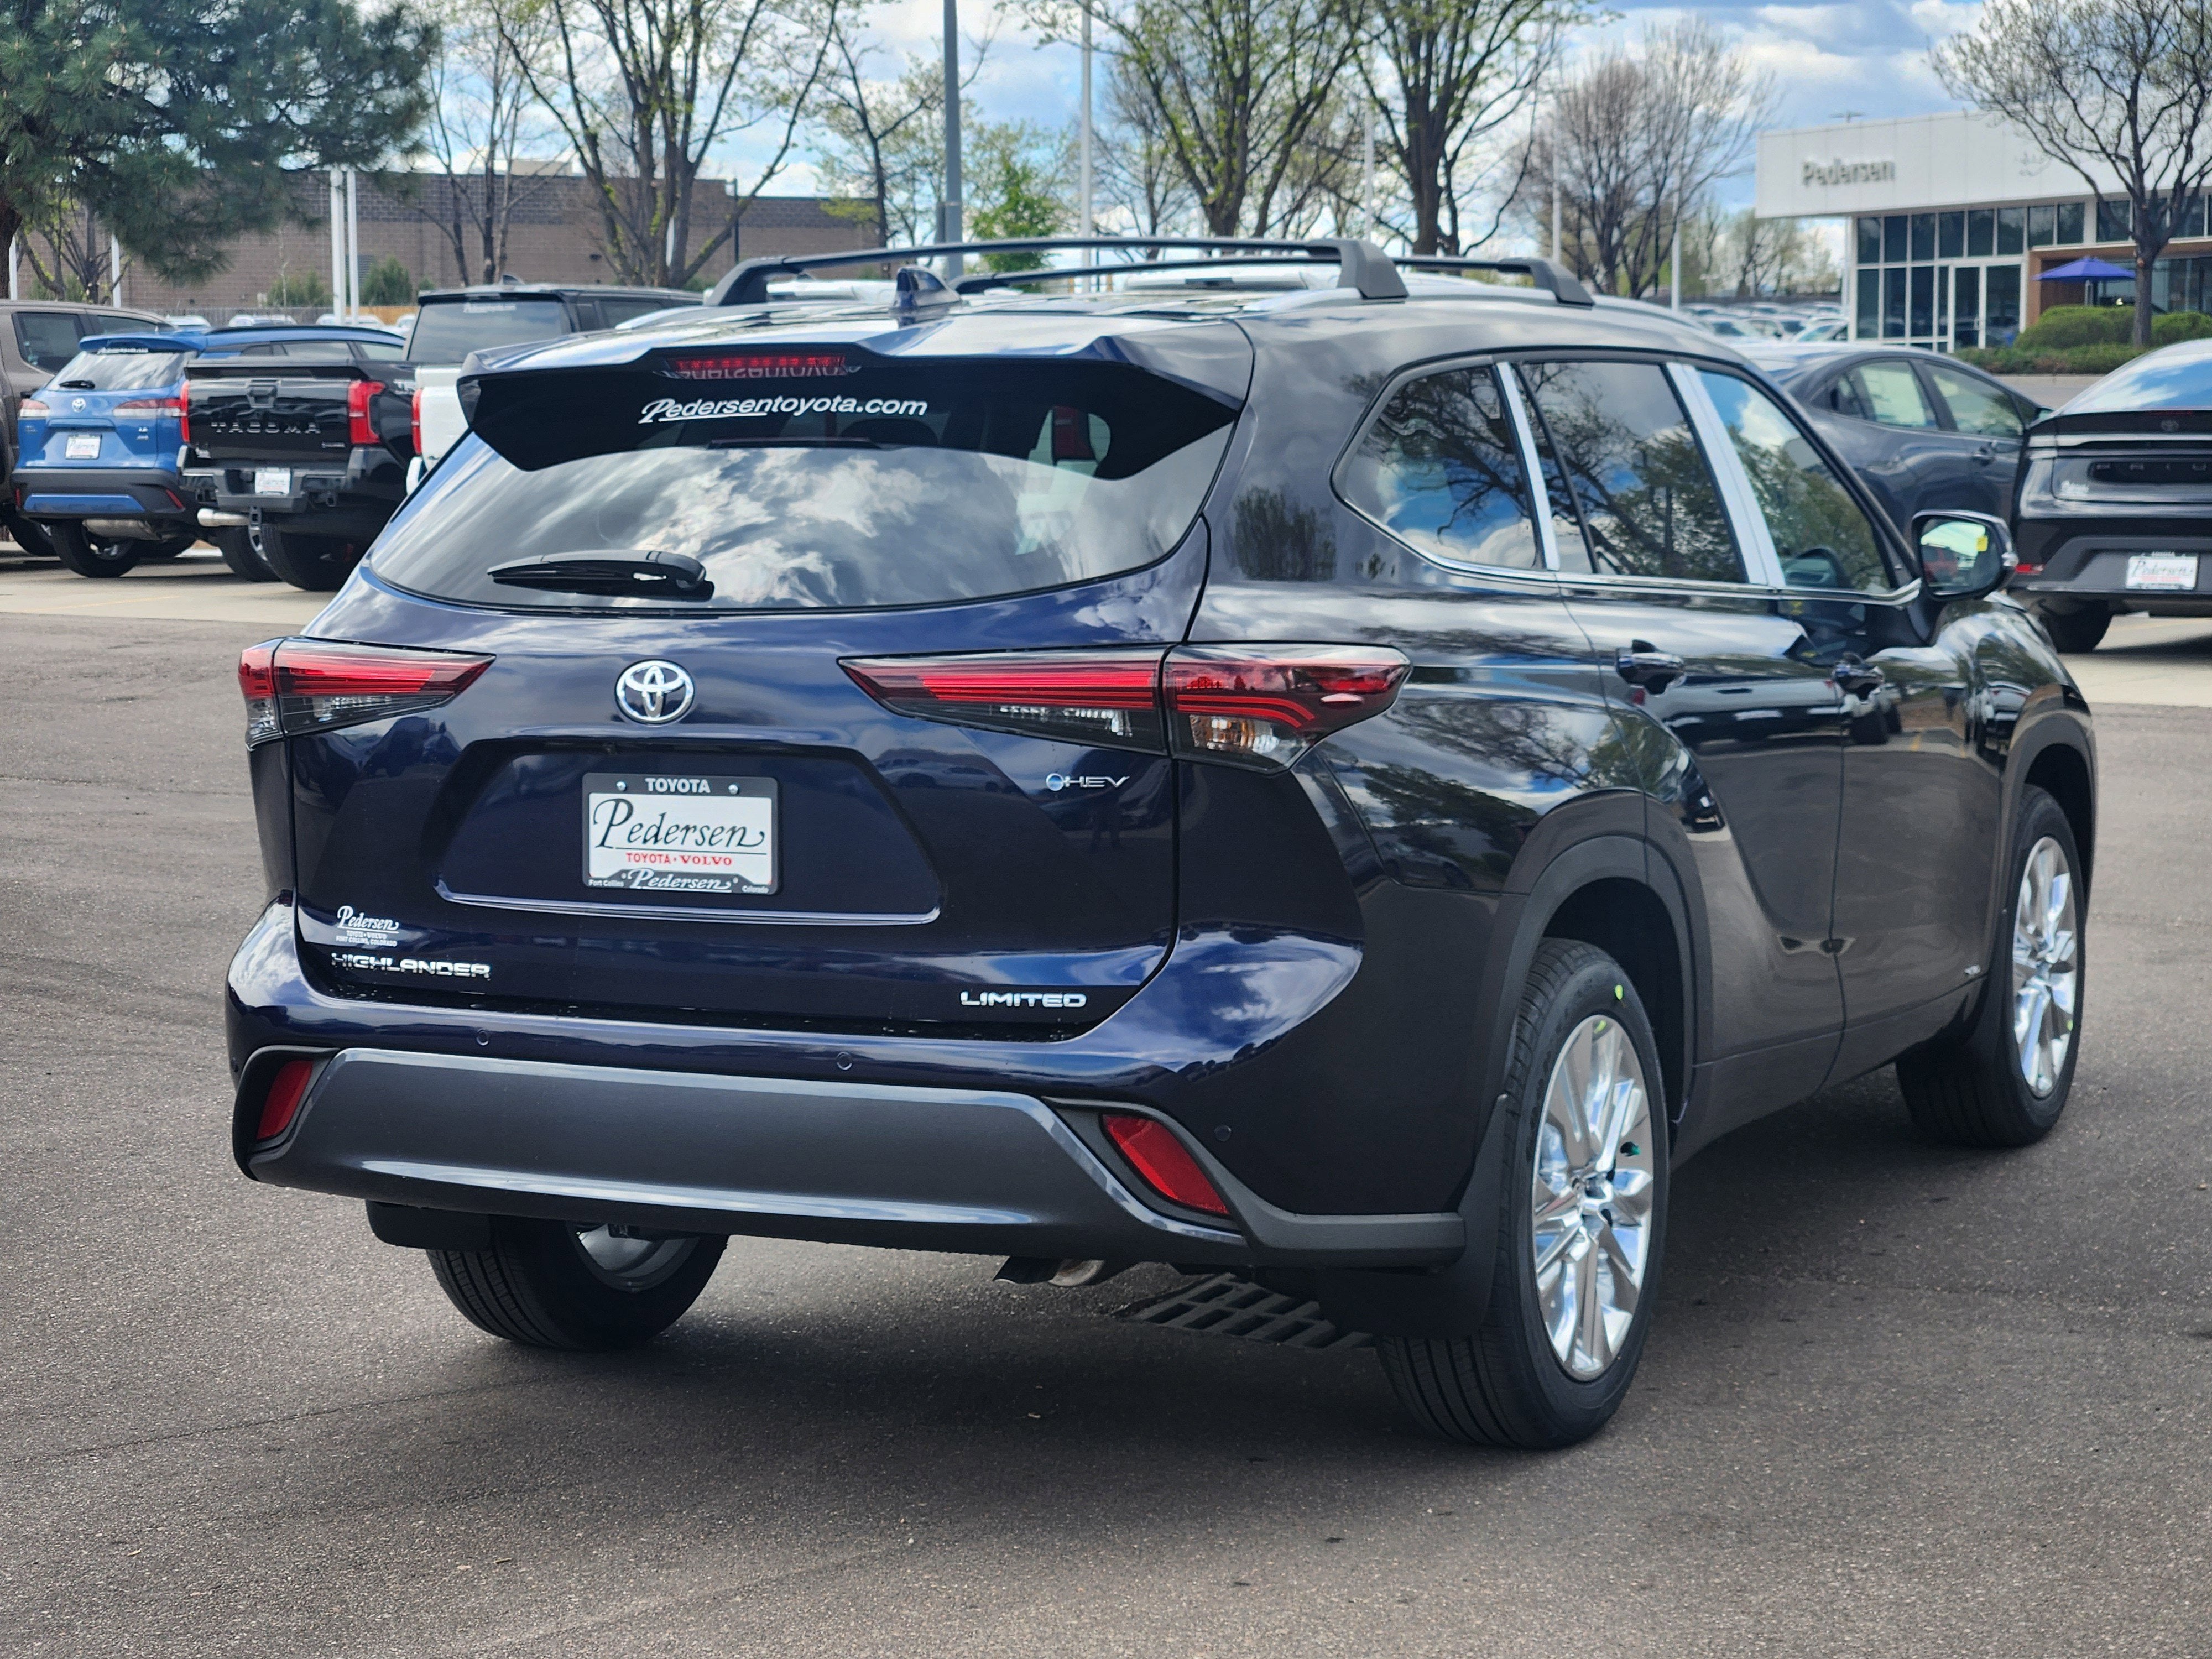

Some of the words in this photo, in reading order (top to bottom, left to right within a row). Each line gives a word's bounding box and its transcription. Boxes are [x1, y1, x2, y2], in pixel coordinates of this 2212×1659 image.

[1802, 158, 1896, 187] Pedersen
[638, 394, 928, 424] Pedersentoyota.com
[211, 421, 321, 434] TACOMA
[645, 778, 711, 794] TOYOTA
[593, 798, 765, 849] Pedersen
[625, 852, 671, 864] TOYOTA
[681, 855, 733, 866] VOLVO
[627, 868, 732, 890] Pedersen
[337, 905, 399, 931] Pedersen
[331, 953, 491, 978] HIGHLANDER
[960, 990, 1087, 1008] LIMITED
